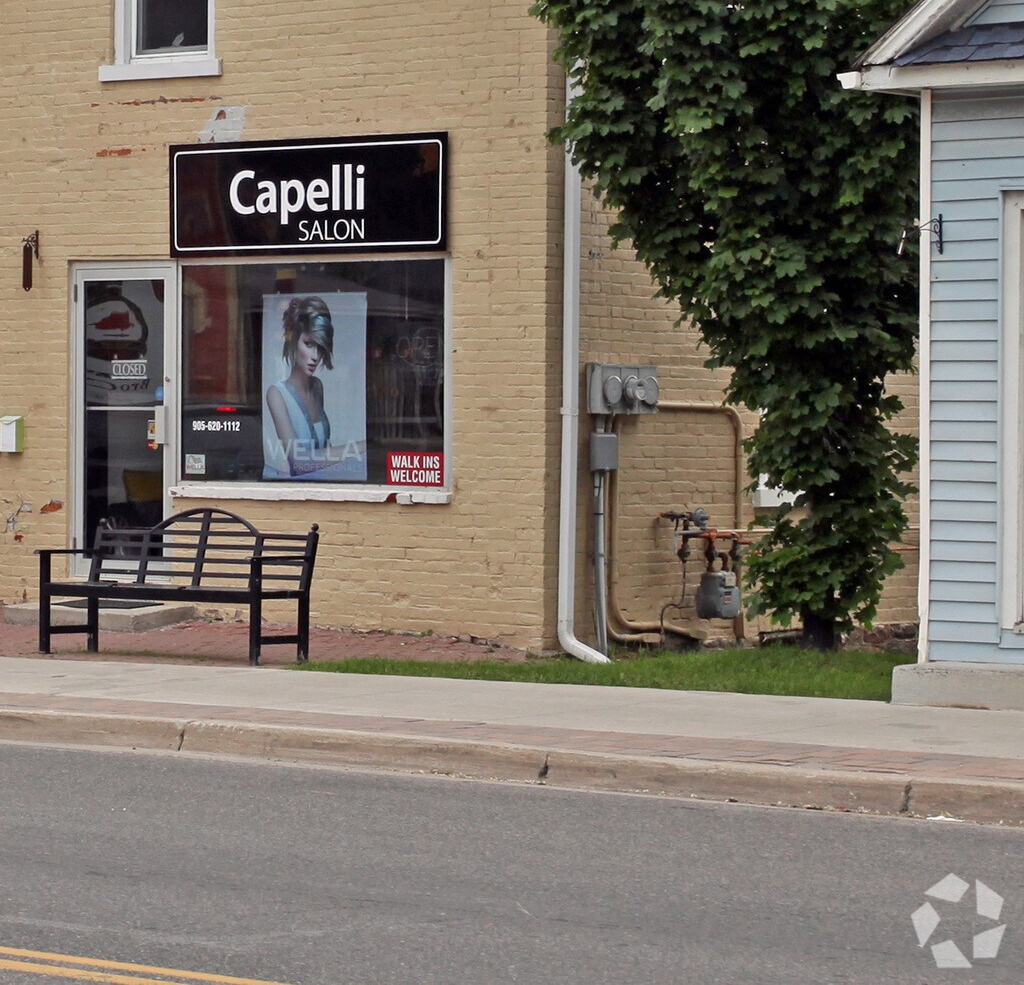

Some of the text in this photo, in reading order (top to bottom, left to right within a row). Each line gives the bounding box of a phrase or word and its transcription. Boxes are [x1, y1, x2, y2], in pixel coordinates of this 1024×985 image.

[229, 164, 366, 225] Capelli
[298, 218, 365, 241] SALON
[112, 363, 146, 376] CLOSED
[192, 421, 241, 431] 905-620-1112
[265, 439, 363, 462] WELLA
[391, 455, 440, 469] WALK INS
[390, 469, 441, 484] WELCOME
